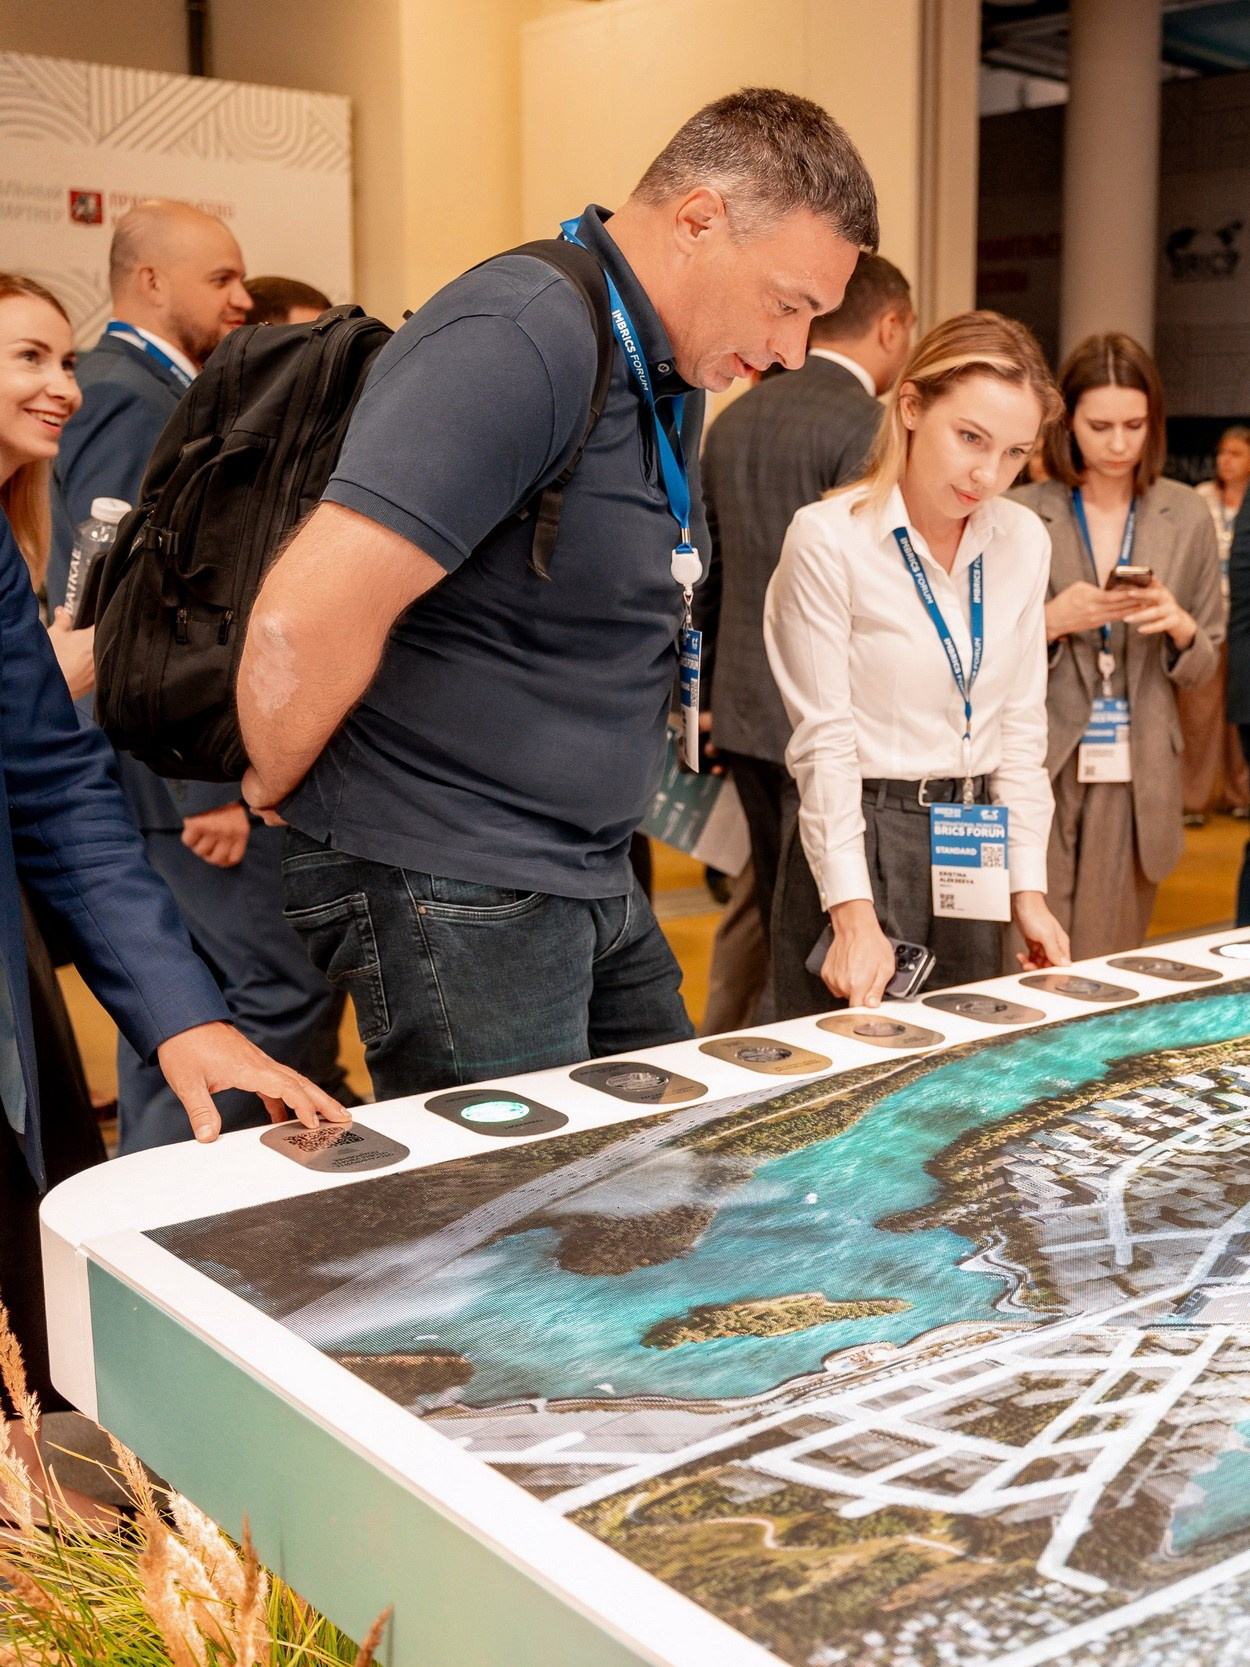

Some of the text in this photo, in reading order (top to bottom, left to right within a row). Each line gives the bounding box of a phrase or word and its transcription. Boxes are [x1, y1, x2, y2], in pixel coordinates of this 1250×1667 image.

[611, 309, 649, 391] IMBRICS FORUM
[900, 537, 934, 604] IMBRICS FORUM
[973, 569, 981, 604] IMBRICS
[943, 637, 962, 674] IMBRICS
[972, 637, 982, 670] FORUM
[934, 824, 965, 837] BRICS
[966, 826, 1005, 839] FORUM
[935, 846, 977, 856] STANDARD
